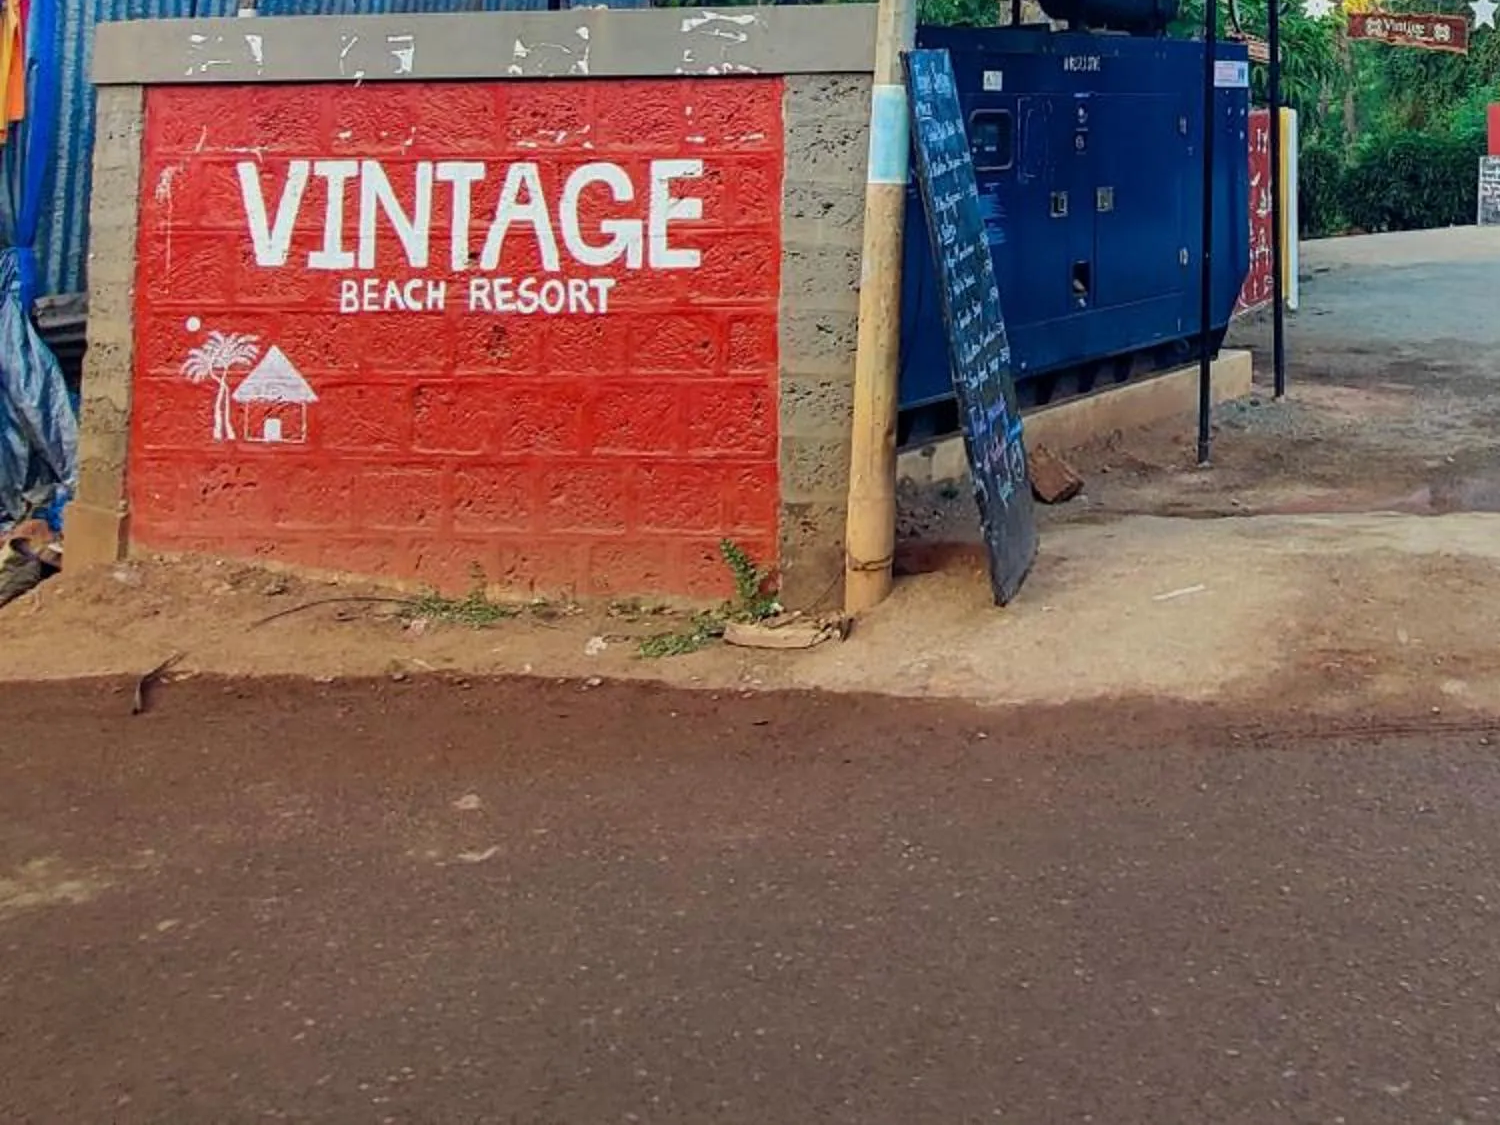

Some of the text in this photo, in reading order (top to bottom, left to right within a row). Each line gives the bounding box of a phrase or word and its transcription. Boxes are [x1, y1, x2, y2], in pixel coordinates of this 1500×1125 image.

[237, 159, 704, 272] VINTAGE
[340, 277, 616, 313] BEACH RESORT
